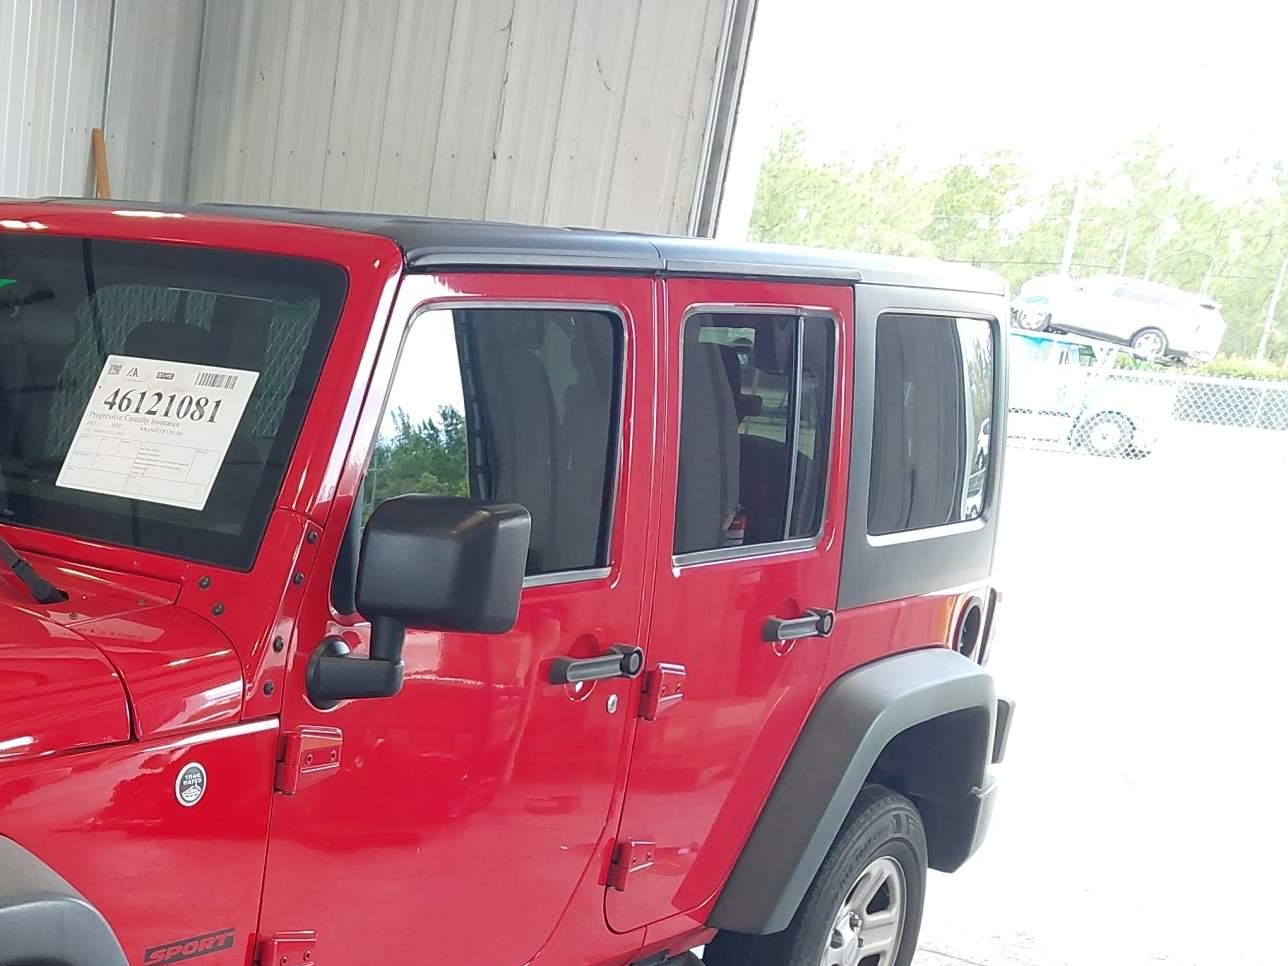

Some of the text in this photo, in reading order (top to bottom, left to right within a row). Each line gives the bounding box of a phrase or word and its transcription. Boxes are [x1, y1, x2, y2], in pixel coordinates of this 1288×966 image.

[89, 410, 181, 428] Progressive Casualty Insurance
[103, 387, 223, 424] 46121081
[147, 931, 235, 963] SPORT
